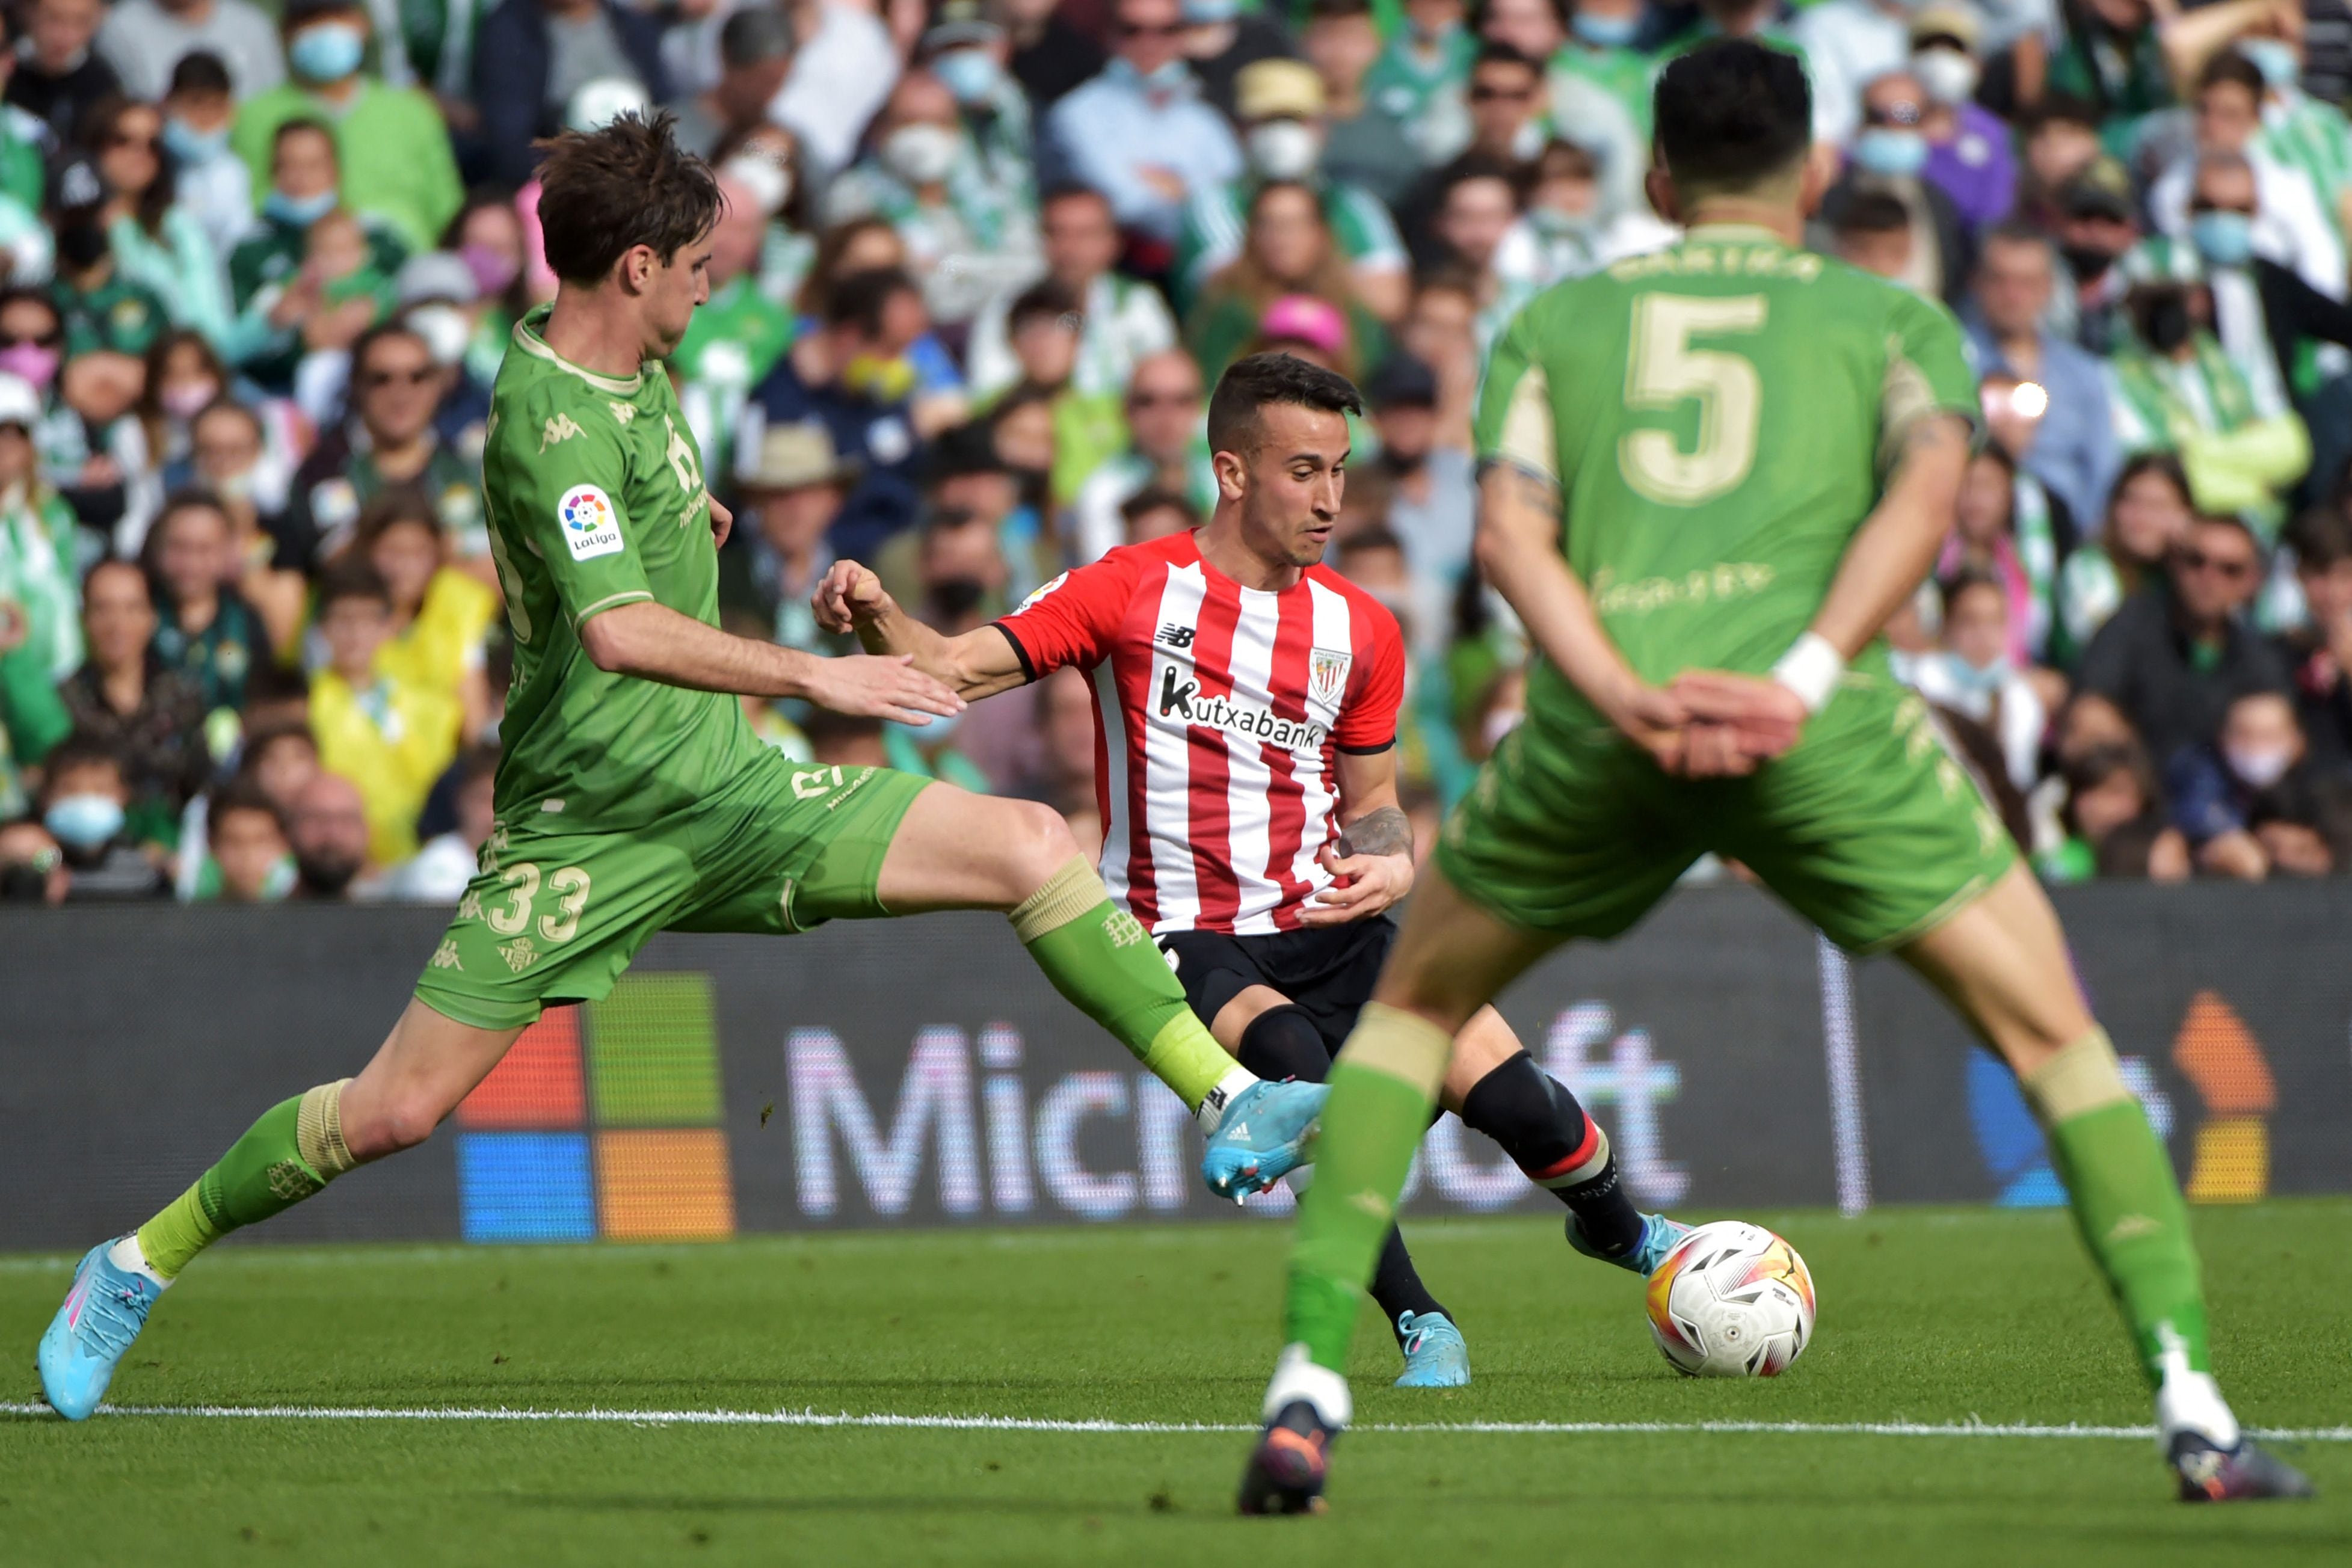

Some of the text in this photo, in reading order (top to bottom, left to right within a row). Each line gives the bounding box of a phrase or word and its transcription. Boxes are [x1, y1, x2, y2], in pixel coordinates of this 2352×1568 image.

[1618, 293, 1766, 507] 5
[574, 533, 617, 550] LaLiga
[1160, 666, 1319, 748] Kutxabank
[487, 862, 591, 942] 33
[784, 1003, 1690, 1219] Microft
